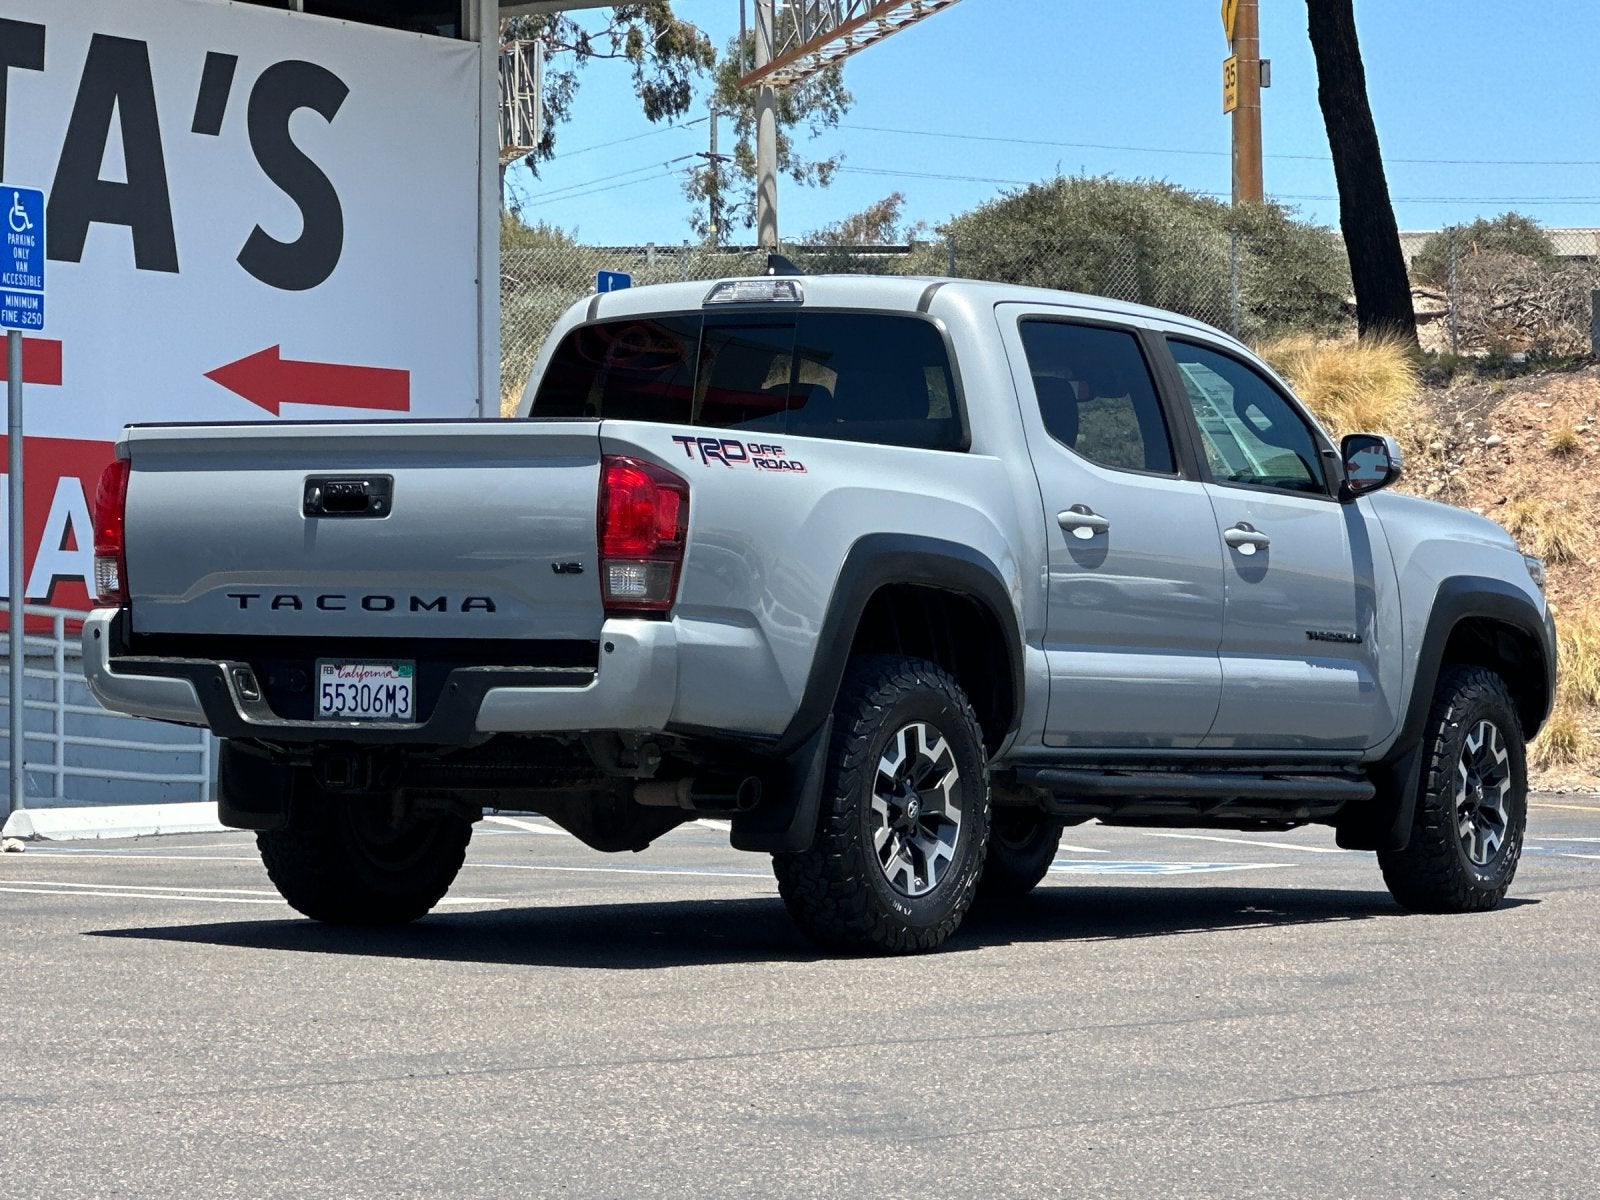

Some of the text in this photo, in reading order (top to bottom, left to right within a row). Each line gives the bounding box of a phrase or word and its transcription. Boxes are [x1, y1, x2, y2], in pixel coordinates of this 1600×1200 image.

[1225, 63, 1236, 89] 35
[7, 232, 35, 247] PARKING
[13, 247, 30, 260] ONLY
[15, 261, 28, 273] VAN
[2, 273, 42, 288] ACCESSIBLE
[5, 294, 39, 310] MINIMUM
[1, 309, 42, 326] FINE $250
[672, 435, 786, 468] TRD OFF
[753, 458, 808, 473] ROAD
[227, 593, 497, 613] TACOMA
[323, 666, 335, 675] FEB
[337, 664, 399, 683] California
[322, 683, 409, 713] 55306M3
